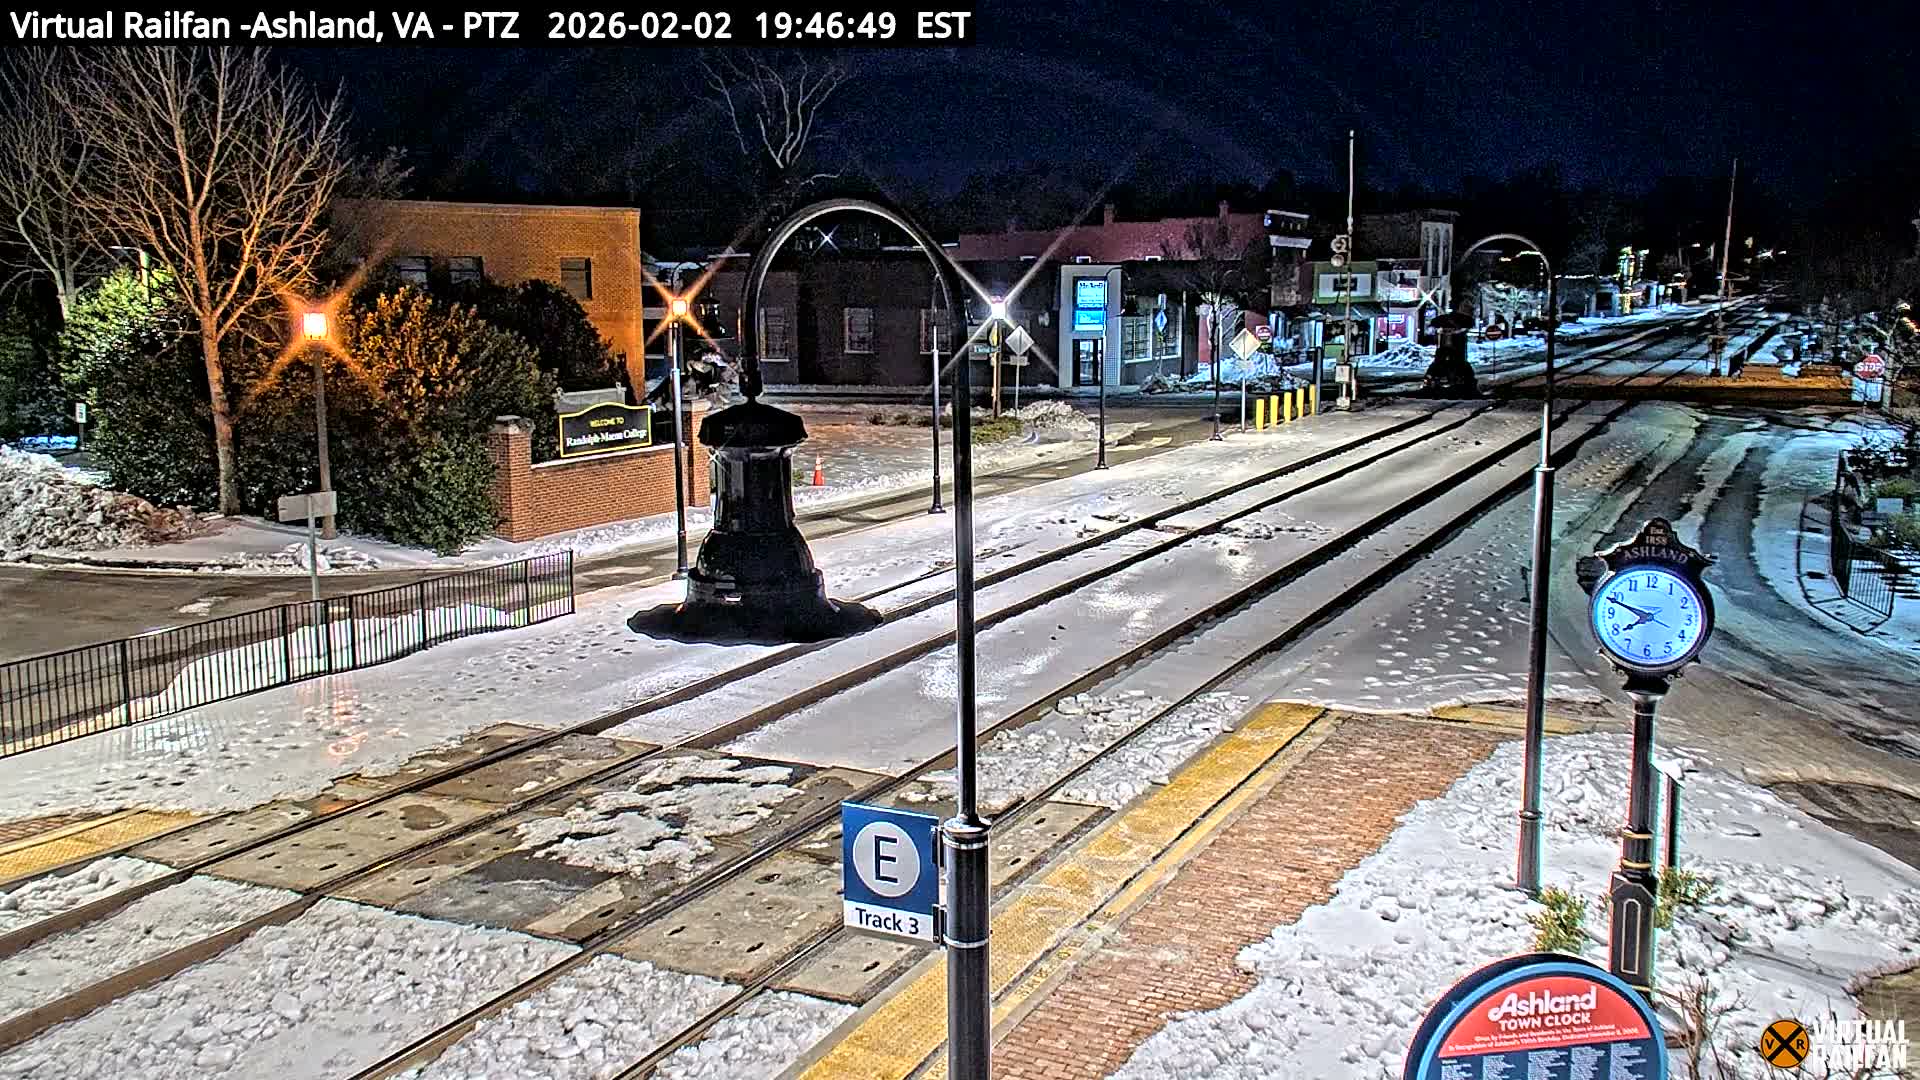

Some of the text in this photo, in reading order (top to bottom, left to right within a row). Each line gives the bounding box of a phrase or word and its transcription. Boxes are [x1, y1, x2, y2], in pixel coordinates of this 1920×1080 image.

[1856, 362, 1882, 372] STOP
[623, 428, 647, 440] College
[1624, 547, 1688, 564] ASHLAND
[1628, 579, 1638, 592] 11
[1646, 576, 1659, 589] 12
[1668, 583, 1673, 595] 1
[1680, 596, 1689, 609] 2
[1607, 607, 1615, 619] 9
[1685, 614, 1693, 627] 3
[1611, 623, 1620, 636] 8
[1678, 630, 1686, 642] 4
[1624, 638, 1632, 650] 7
[1643, 644, 1651, 657] 6
[1664, 642, 1673, 654] 5
[874, 835, 898, 884] E
[855, 907, 919, 935] Track 3
[1488, 986, 1597, 1022] Ashland
[1499, 1012, 1591, 1031] TOWN CLOCK
